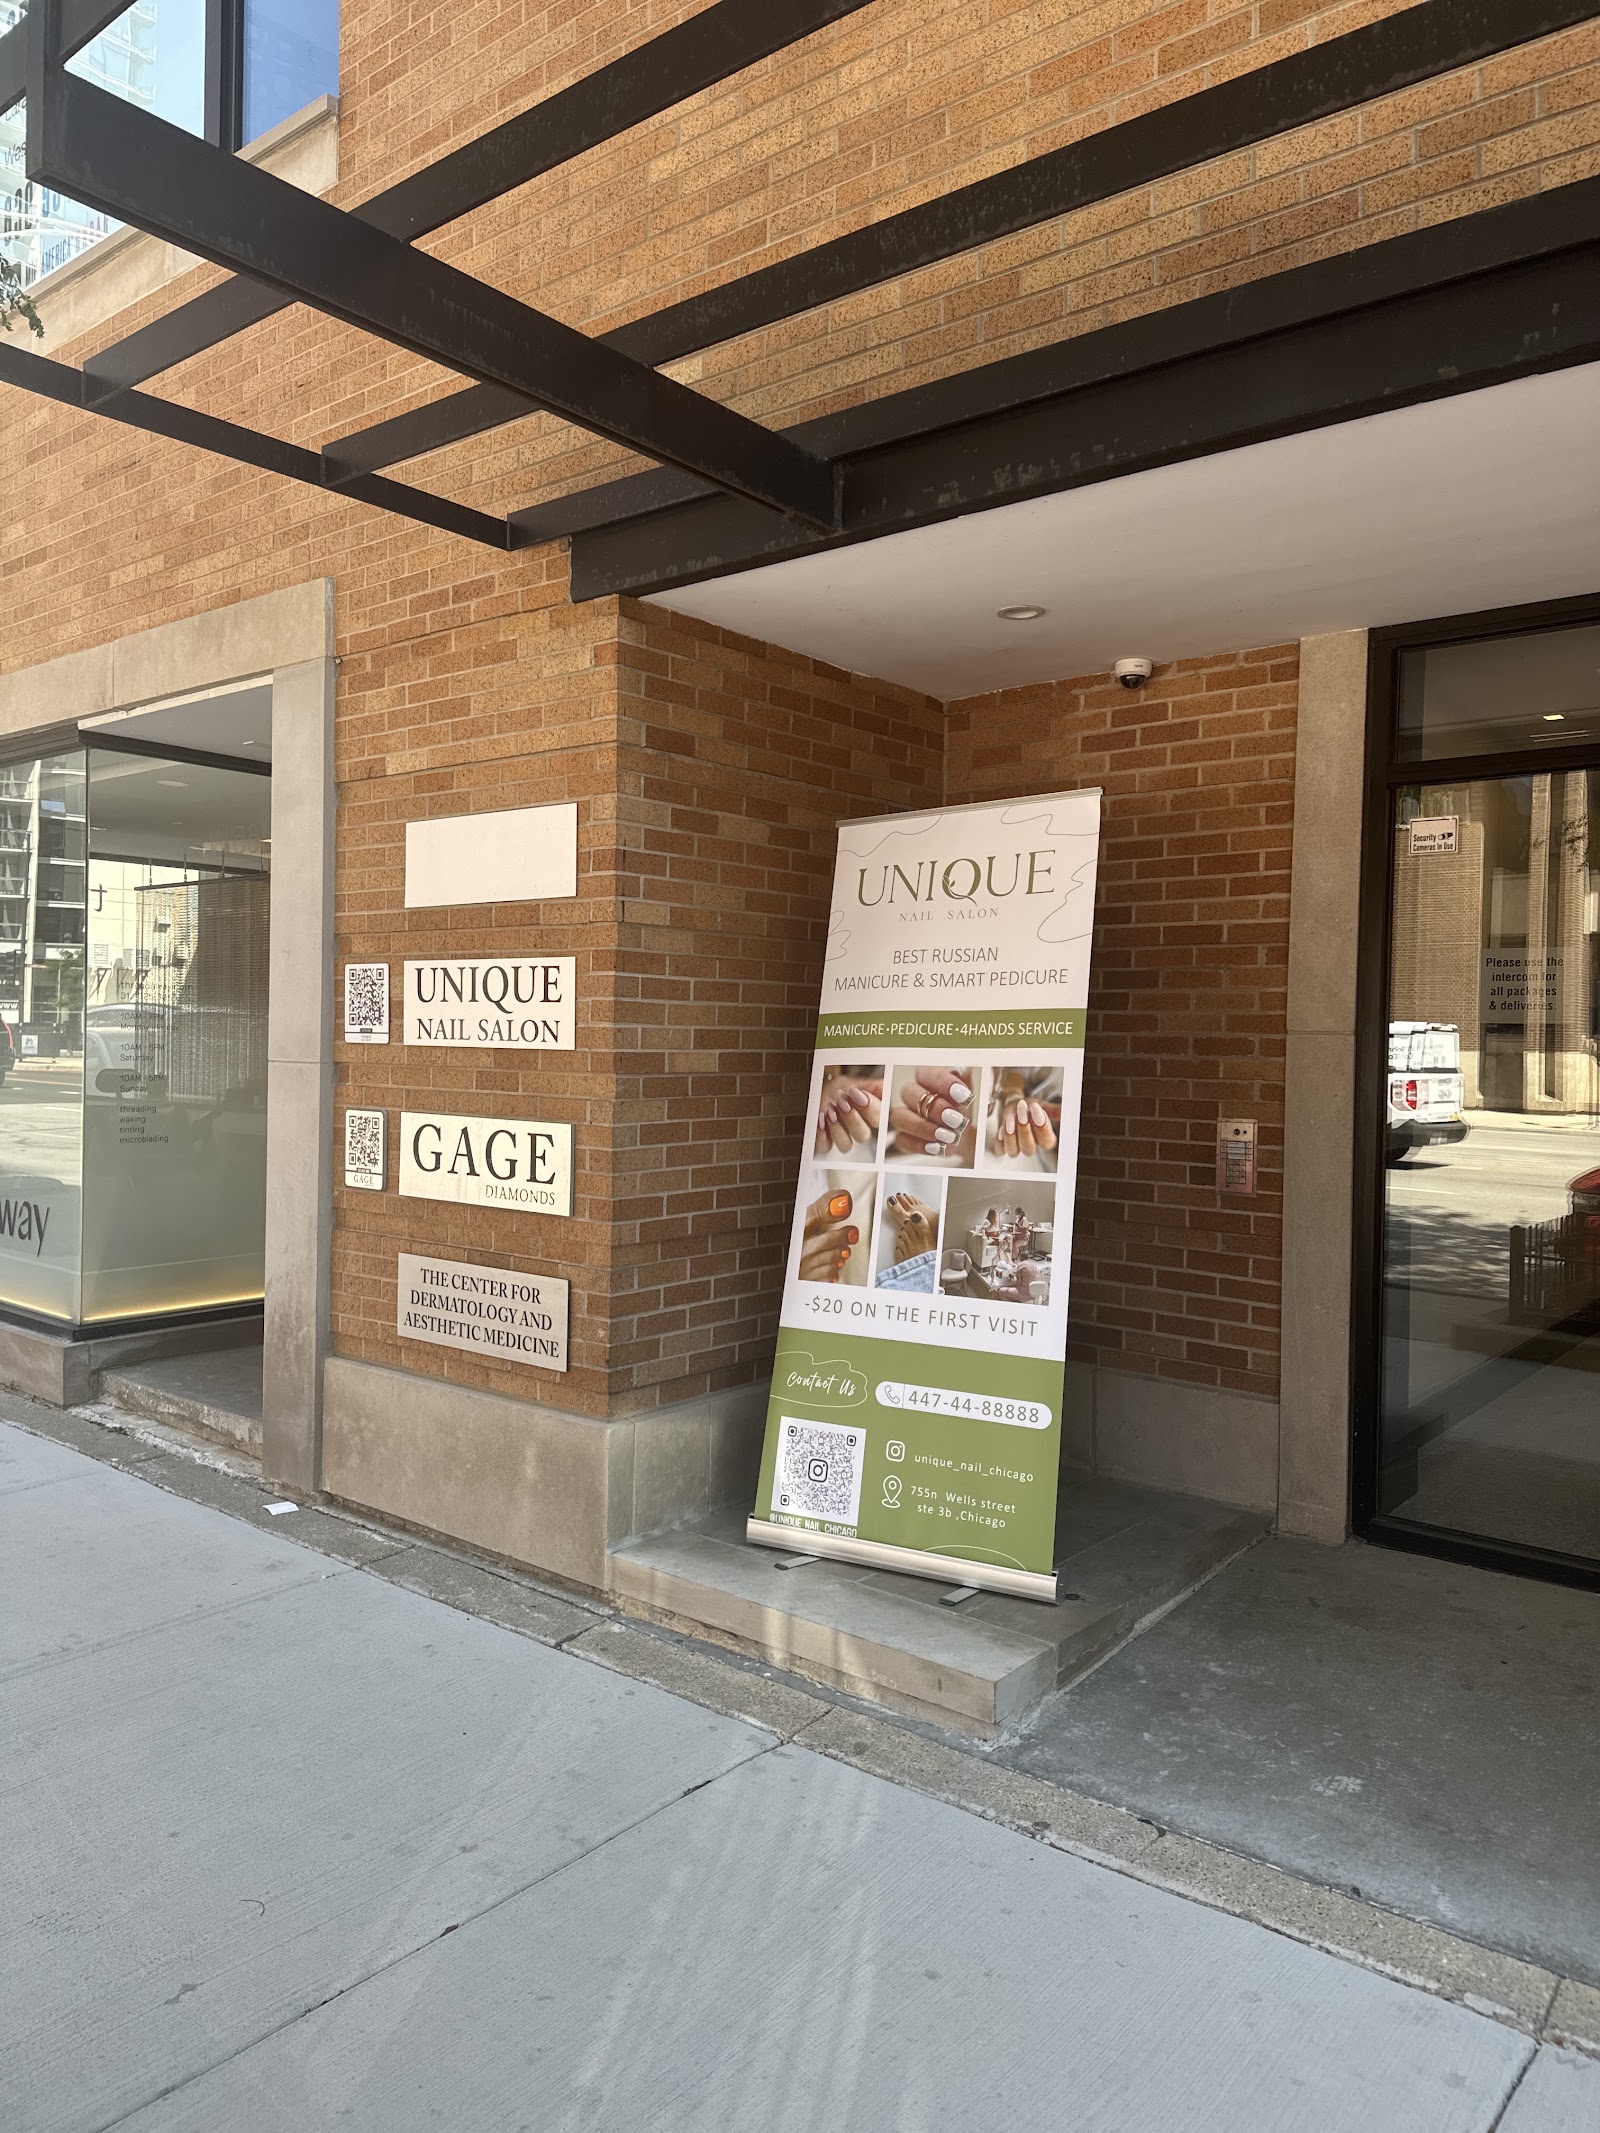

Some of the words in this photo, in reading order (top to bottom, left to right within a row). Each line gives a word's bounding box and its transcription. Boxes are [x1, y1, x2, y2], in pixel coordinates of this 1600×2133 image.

[1413, 833, 1436, 842] Security
[1413, 843, 1436, 852] Cameras
[1444, 842, 1453, 850] Use
[858, 850, 1056, 906] UNIQUE
[898, 911, 934, 923] NAIL
[947, 907, 1000, 920] SALON
[893, 949, 928, 965] BEST
[932, 947, 999, 963] RUSSIAN
[1485, 957, 1521, 967] Please
[1524, 958, 1543, 967] use
[1546, 956, 1564, 967] the
[834, 973, 909, 991] MANICURE
[913, 972, 925, 988] &
[929, 972, 986, 988] SMART
[989, 968, 1069, 986] PEDICURE
[1492, 971, 1538, 981] intercom
[415, 965, 563, 1015] UNIQUE
[1490, 986, 1504, 996] all
[1507, 986, 1557, 998] packages
[1489, 1000, 1497, 1010] &
[416, 1018, 471, 1041] NAIL
[477, 1018, 561, 1043] SALON
[1017, 1021, 1074, 1035] SERVICE
[120, 1085, 149, 1093] Sunday
[120, 1105, 157, 1114] threading
[120, 1126, 145, 1134] tinting
[120, 1135, 169, 1143] microblading
[413, 1123, 556, 1185] GAGE
[353, 1174, 374, 1185] GAGE
[485, 1184, 556, 1206] DIAMONDS
[420, 1267, 449, 1288] THE
[451, 1273, 508, 1299] CENTER
[511, 1283, 542, 1305] FOR
[410, 1289, 519, 1324] DERMATOLOGY
[519, 1310, 553, 1331] AND
[805, 1295, 843, 1314] -$20
[850, 1301, 877, 1318] ON
[885, 1304, 920, 1323] THE
[928, 1310, 980, 1330] FIRST
[988, 1316, 1038, 1337] VISIT
[403, 1311, 481, 1341] AESTHETIC
[483, 1327, 560, 1358] MEDICINE
[786, 1371, 839, 1394] Contact
[839, 1378, 857, 1397] Us
[908, 1390, 1040, 1423] 447-44-88888
[914, 1454, 1034, 1483] unique_nail_chicago
[910, 1485, 938, 1500] 755n
[946, 1491, 977, 1507] Wells
[980, 1499, 1016, 1514] street
[917, 1503, 934, 1515] ste
[938, 1506, 952, 1518] 3b
